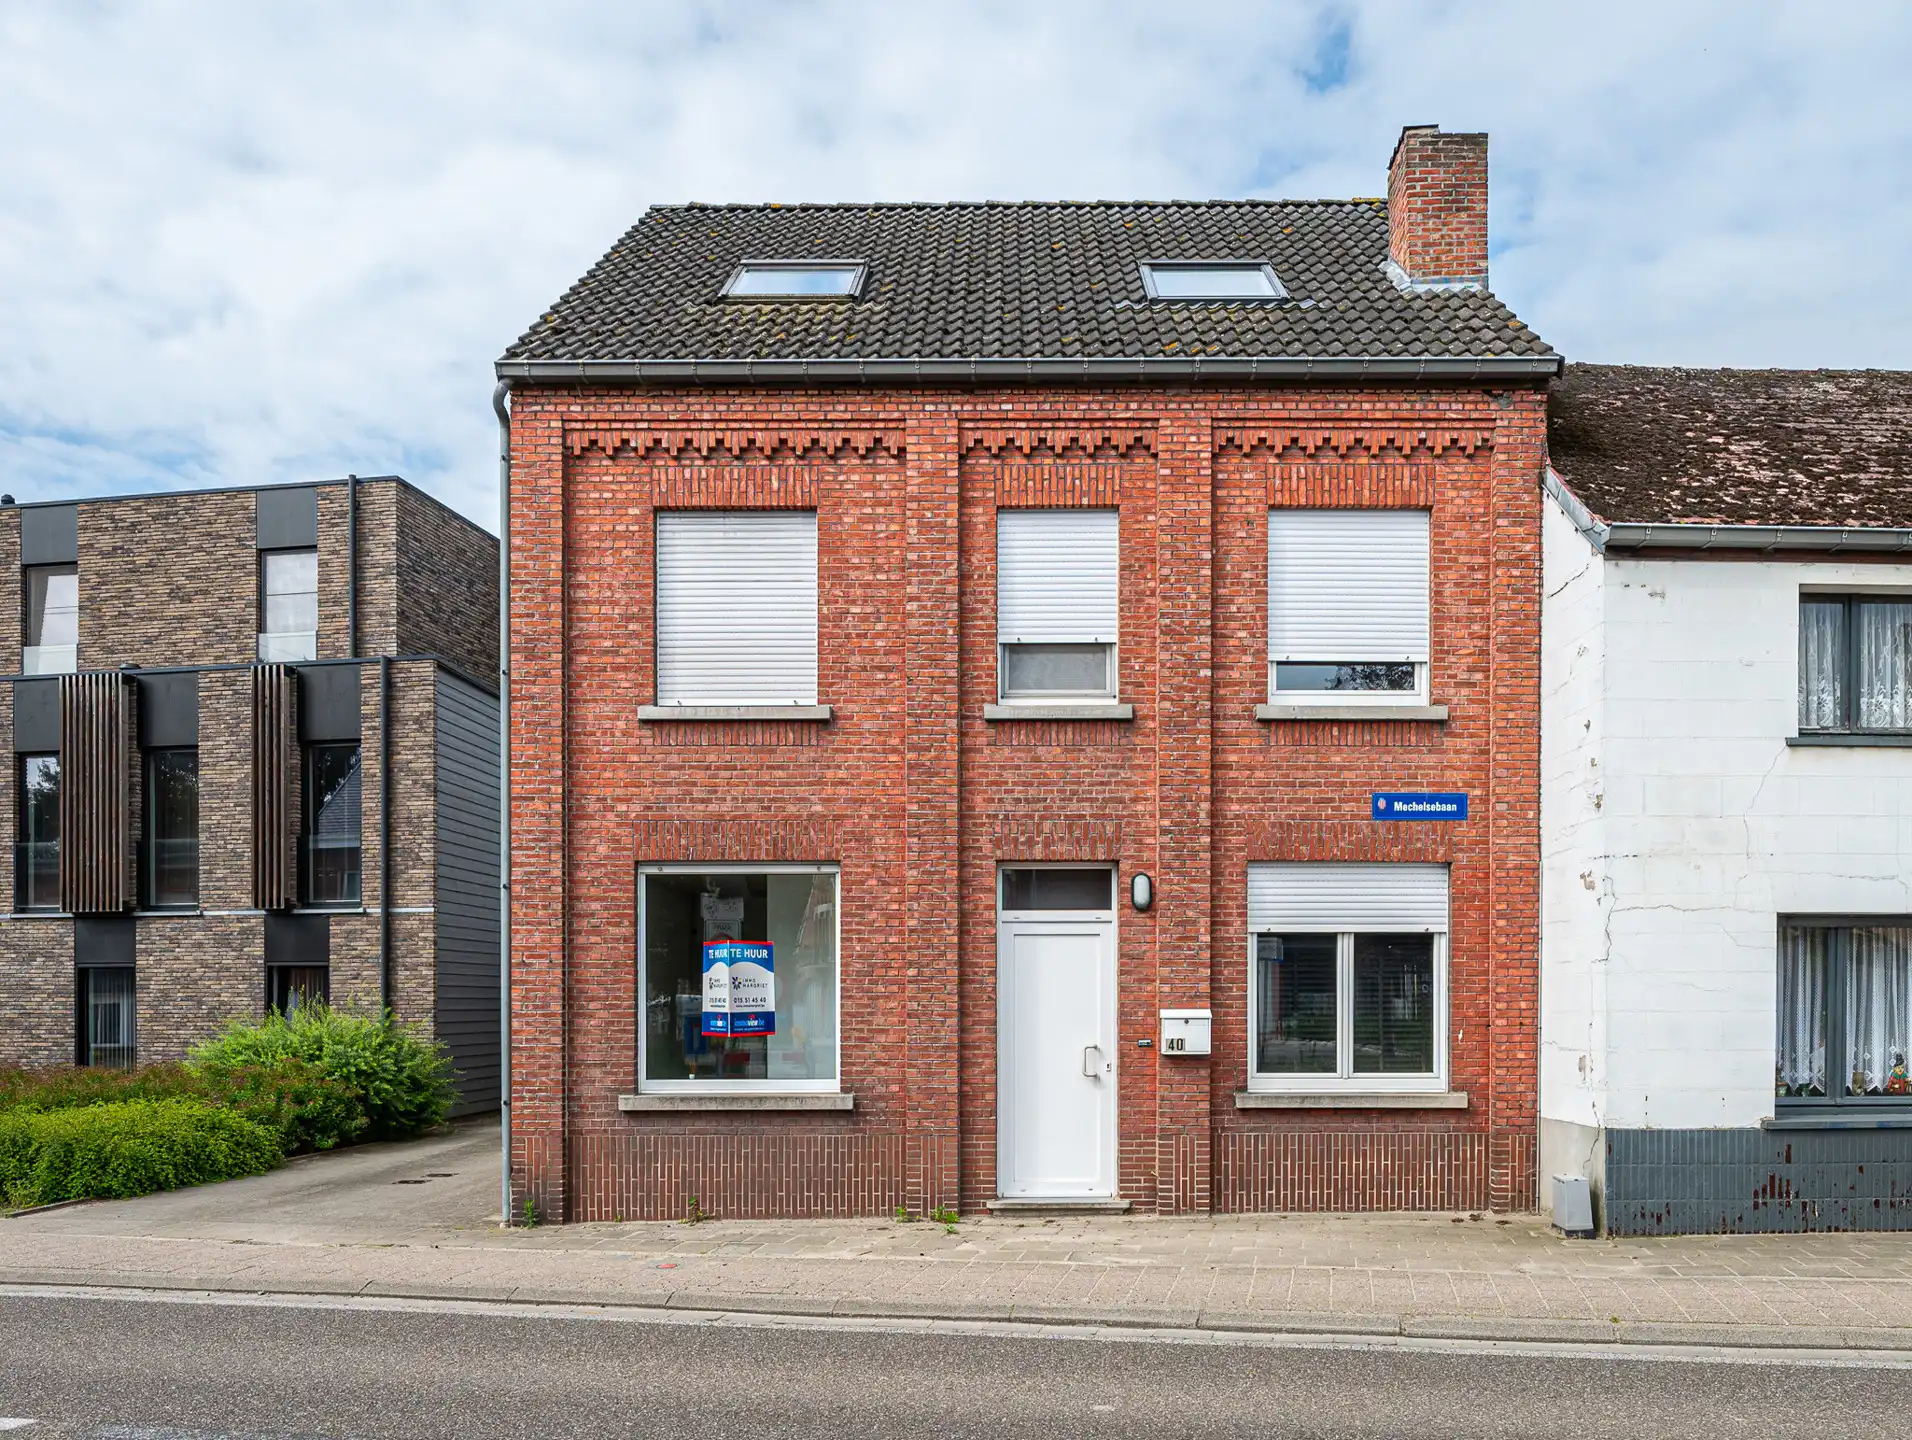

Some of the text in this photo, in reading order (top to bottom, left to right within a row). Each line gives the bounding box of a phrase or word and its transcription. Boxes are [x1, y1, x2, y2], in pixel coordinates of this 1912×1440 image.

[1393, 801, 1457, 812] Mechelsebaan
[729, 948, 768, 959] TE HUUR
[1168, 1038, 1184, 1051] 40
